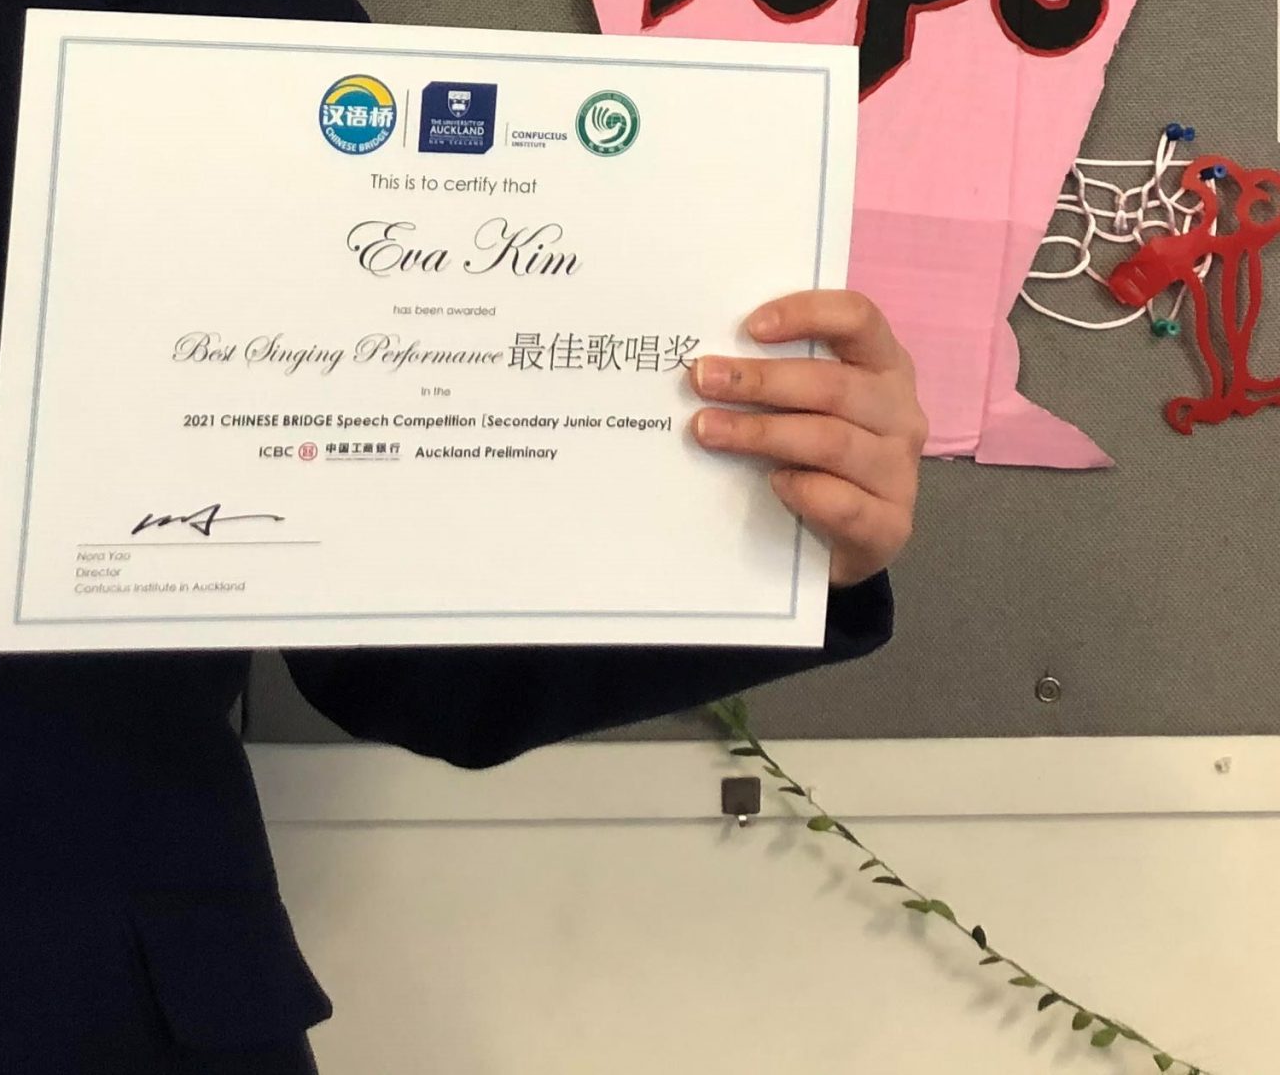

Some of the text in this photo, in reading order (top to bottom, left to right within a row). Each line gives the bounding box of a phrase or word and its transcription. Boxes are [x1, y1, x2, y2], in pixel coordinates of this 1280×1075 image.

[322, 104, 394, 128] 汉语桥
[429, 125, 485, 136] AUCKLAND
[511, 130, 568, 141] CONFUCIUS
[324, 126, 390, 152] CHINESE BRIDGE
[370, 173, 537, 196] This is to certify that
[346, 217, 583, 277] Eva Kim
[392, 304, 496, 316] has been awarded
[172, 331, 504, 376] Best Singing Performance
[507, 331, 701, 372] 最佳歌唱奖
[433, 386, 451, 397] the
[183, 413, 672, 432] 2021 CHINESE BRIDGE Speech Competition [Secondary Junior Category]
[258, 446, 294, 458] ICBC
[325, 442, 401, 454] 中国工商银行
[415, 446, 480, 459] Auckland
[484, 446, 558, 460] Preliminary
[76, 551, 131, 561] Nora Yao
[75, 567, 121, 577] Director
[74, 581, 246, 594] Confucius Institute in Auckland
